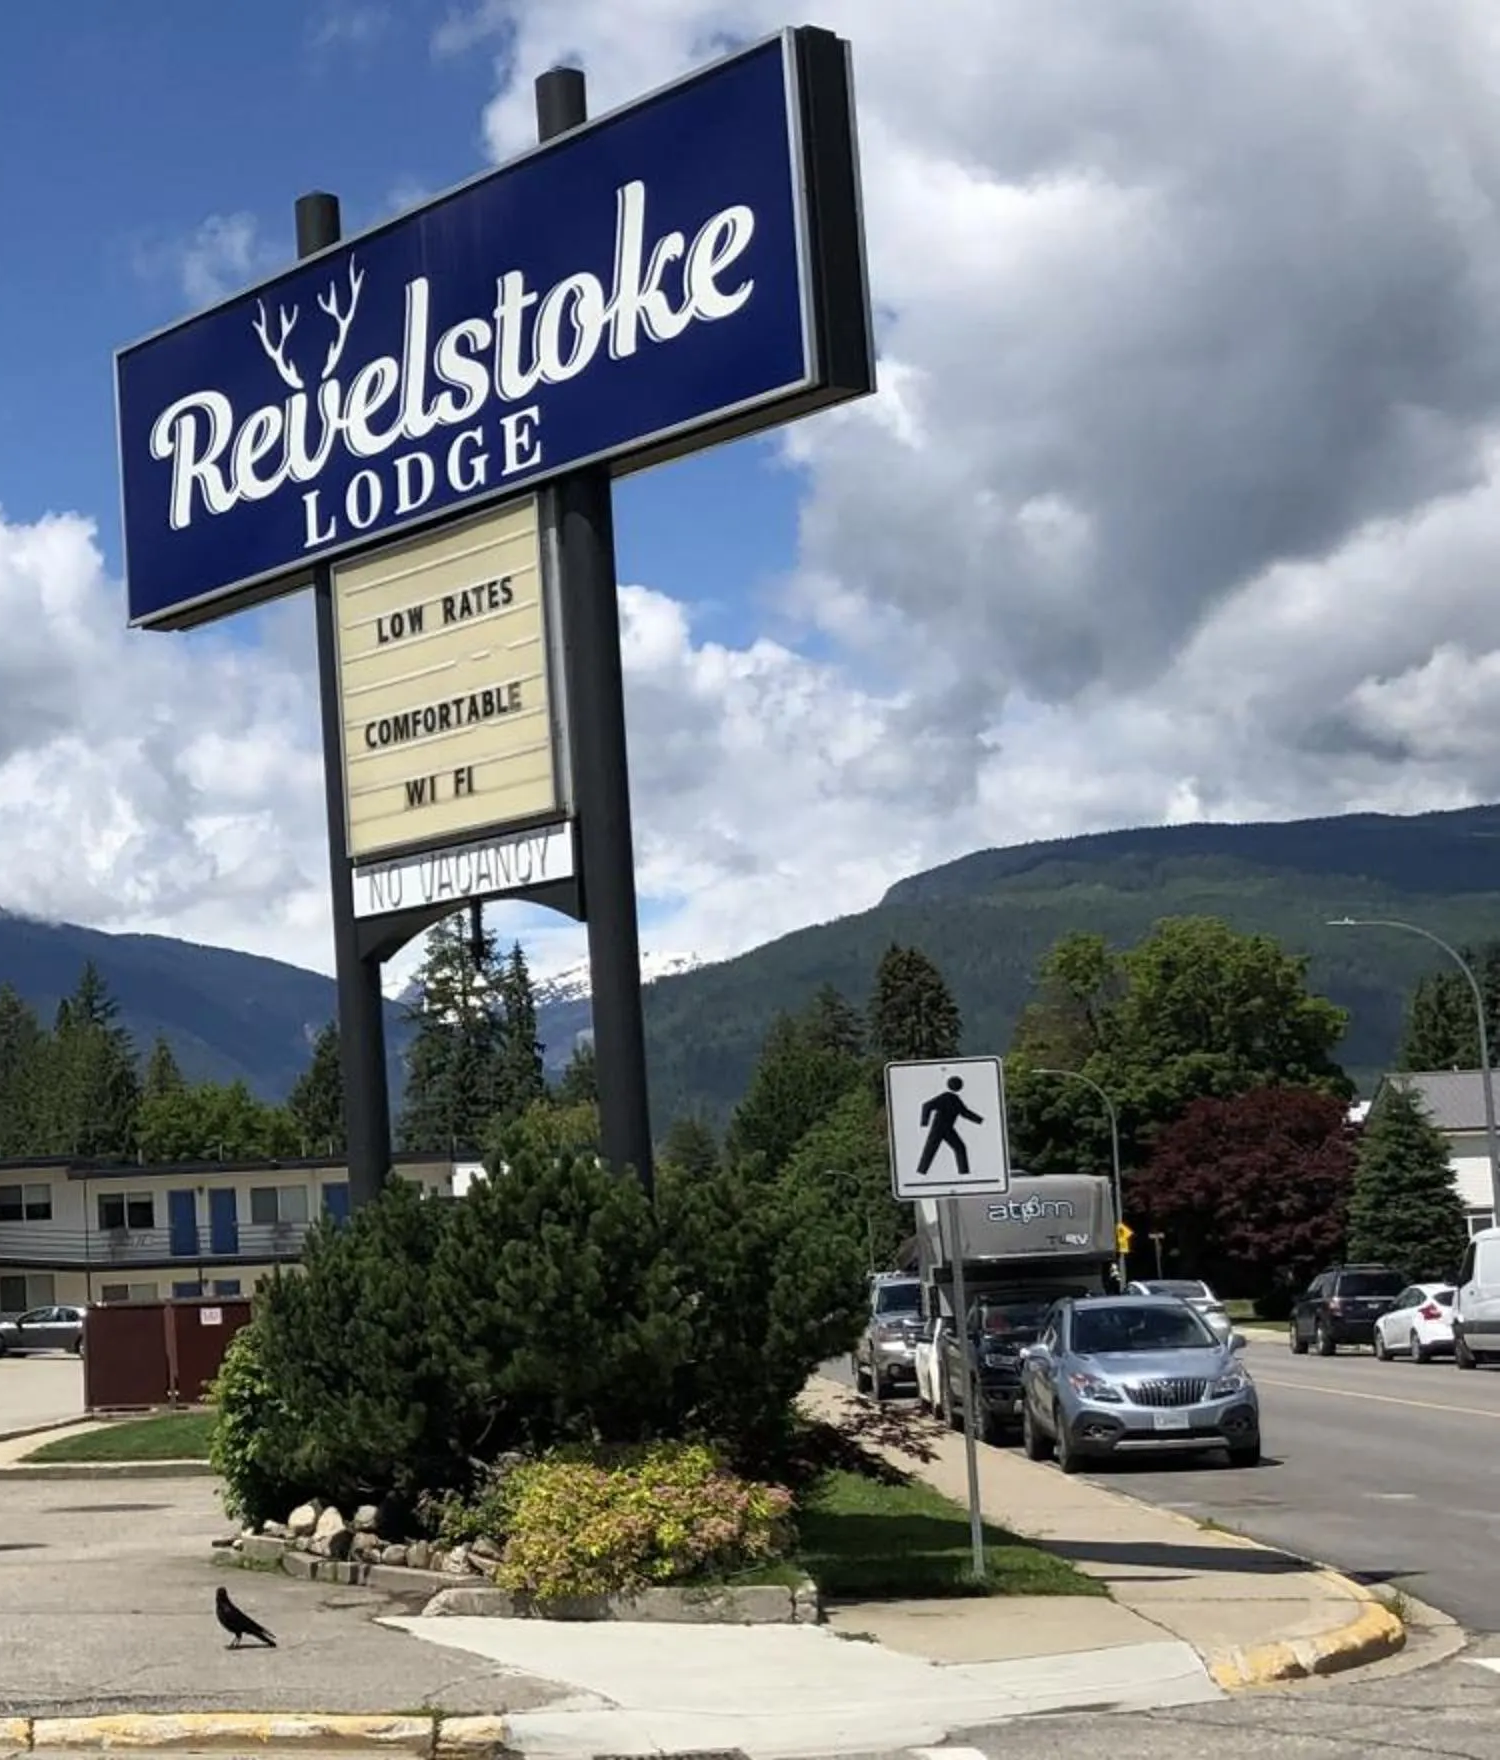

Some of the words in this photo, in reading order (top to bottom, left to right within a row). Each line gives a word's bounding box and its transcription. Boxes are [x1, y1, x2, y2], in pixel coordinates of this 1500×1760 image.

[150, 180, 755, 530] Revelstoke
[304, 406, 542, 548] LODGE
[377, 605, 424, 644] LOW
[441, 575, 514, 624] RATES
[364, 682, 522, 748] COMFORTABLE
[405, 776, 436, 807] WI
[454, 766, 474, 797] FI
[368, 862, 404, 910] NO
[419, 828, 550, 902] VACANCY
